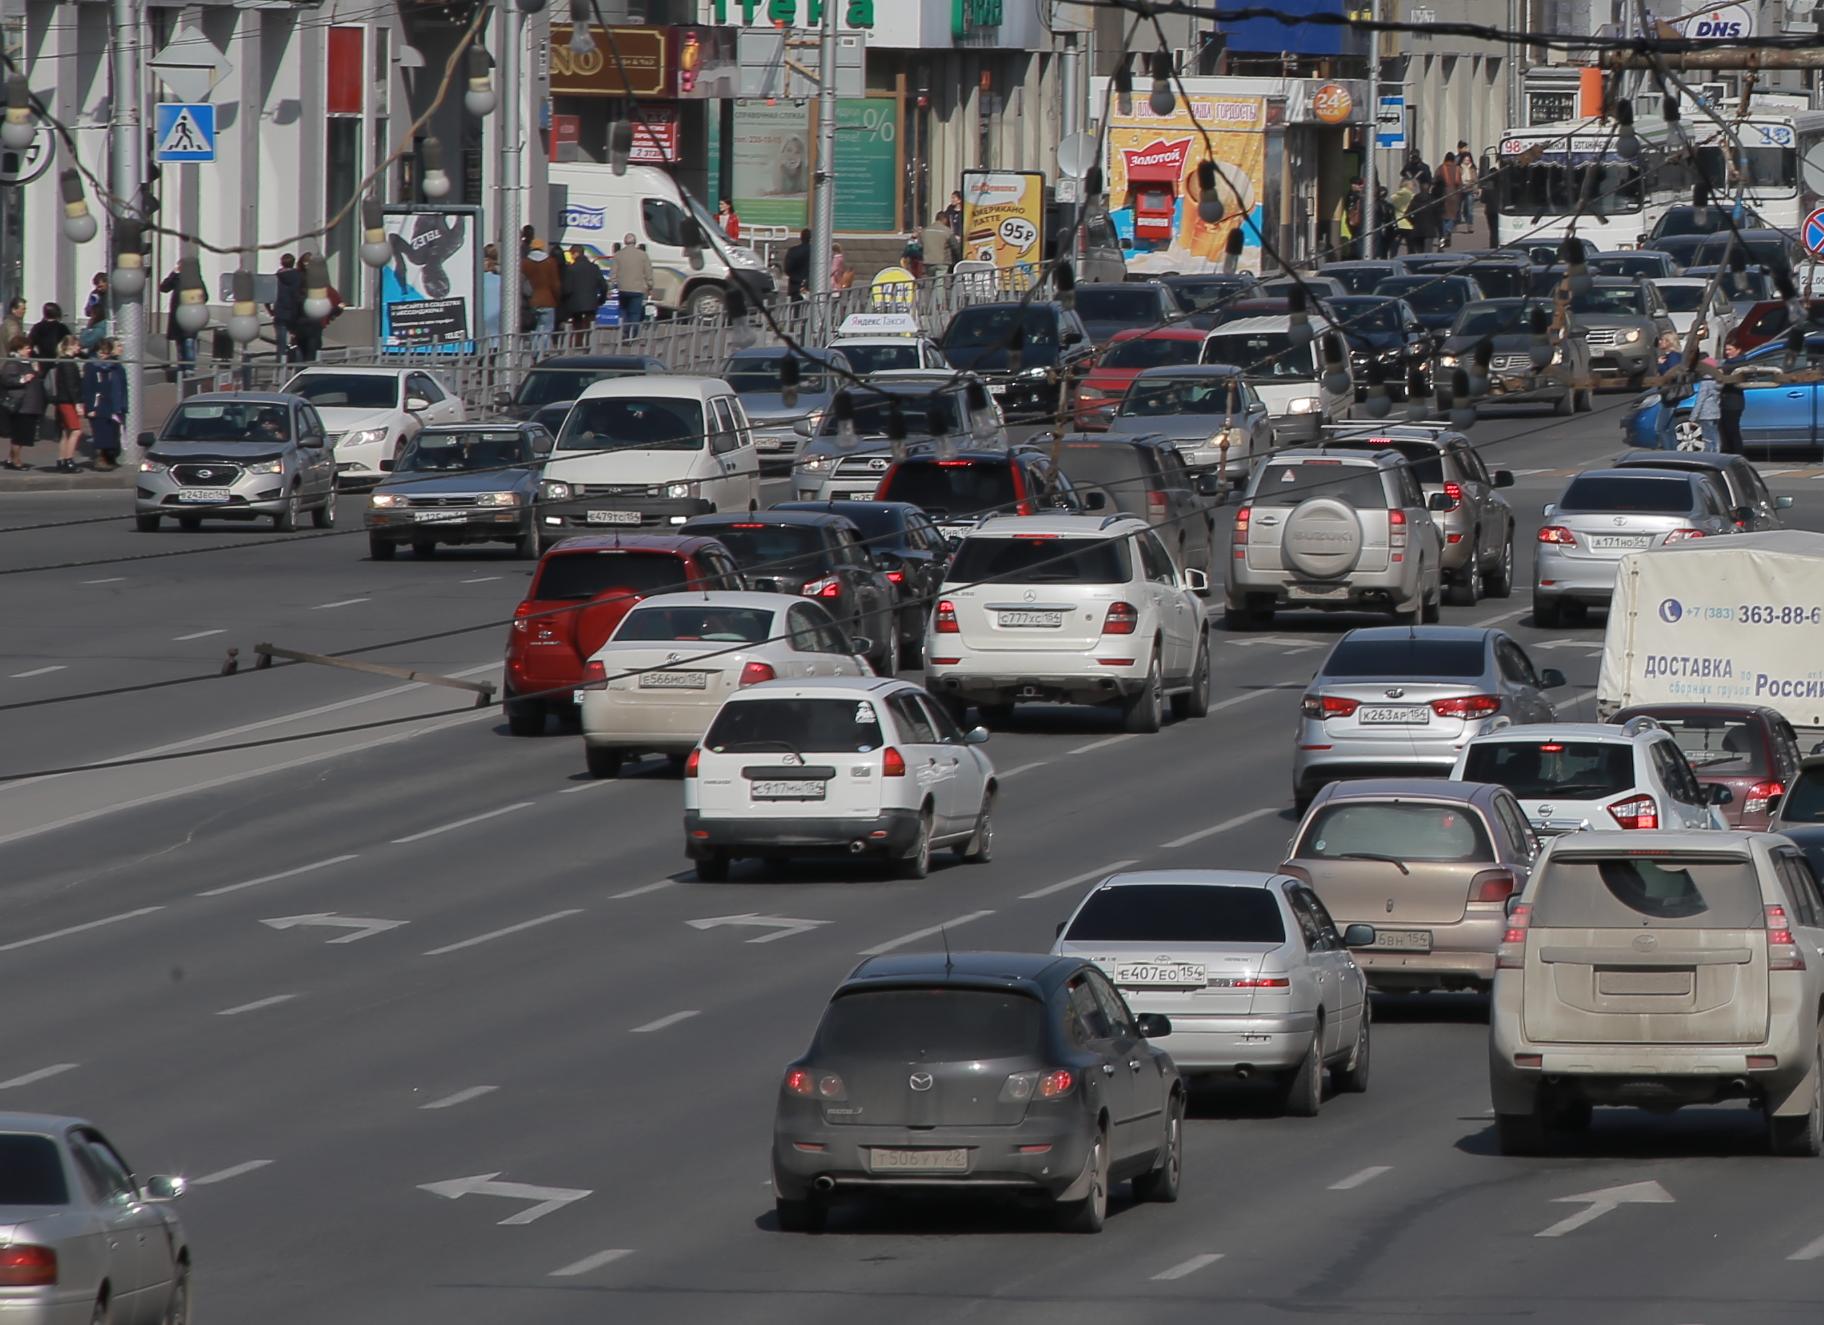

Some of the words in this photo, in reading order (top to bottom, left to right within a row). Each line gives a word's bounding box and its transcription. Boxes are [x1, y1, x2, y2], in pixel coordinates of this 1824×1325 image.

[1696, 22, 1742, 37] DNS
[1317, 93, 1341, 108] 24
[1505, 140, 1521, 152] 98
[1130, 150, 1181, 167] ЗОЛОТОЙ
[1704, 606, 1735, 622] (383)
[1644, 655, 1733, 679] ДОСТАВКА
